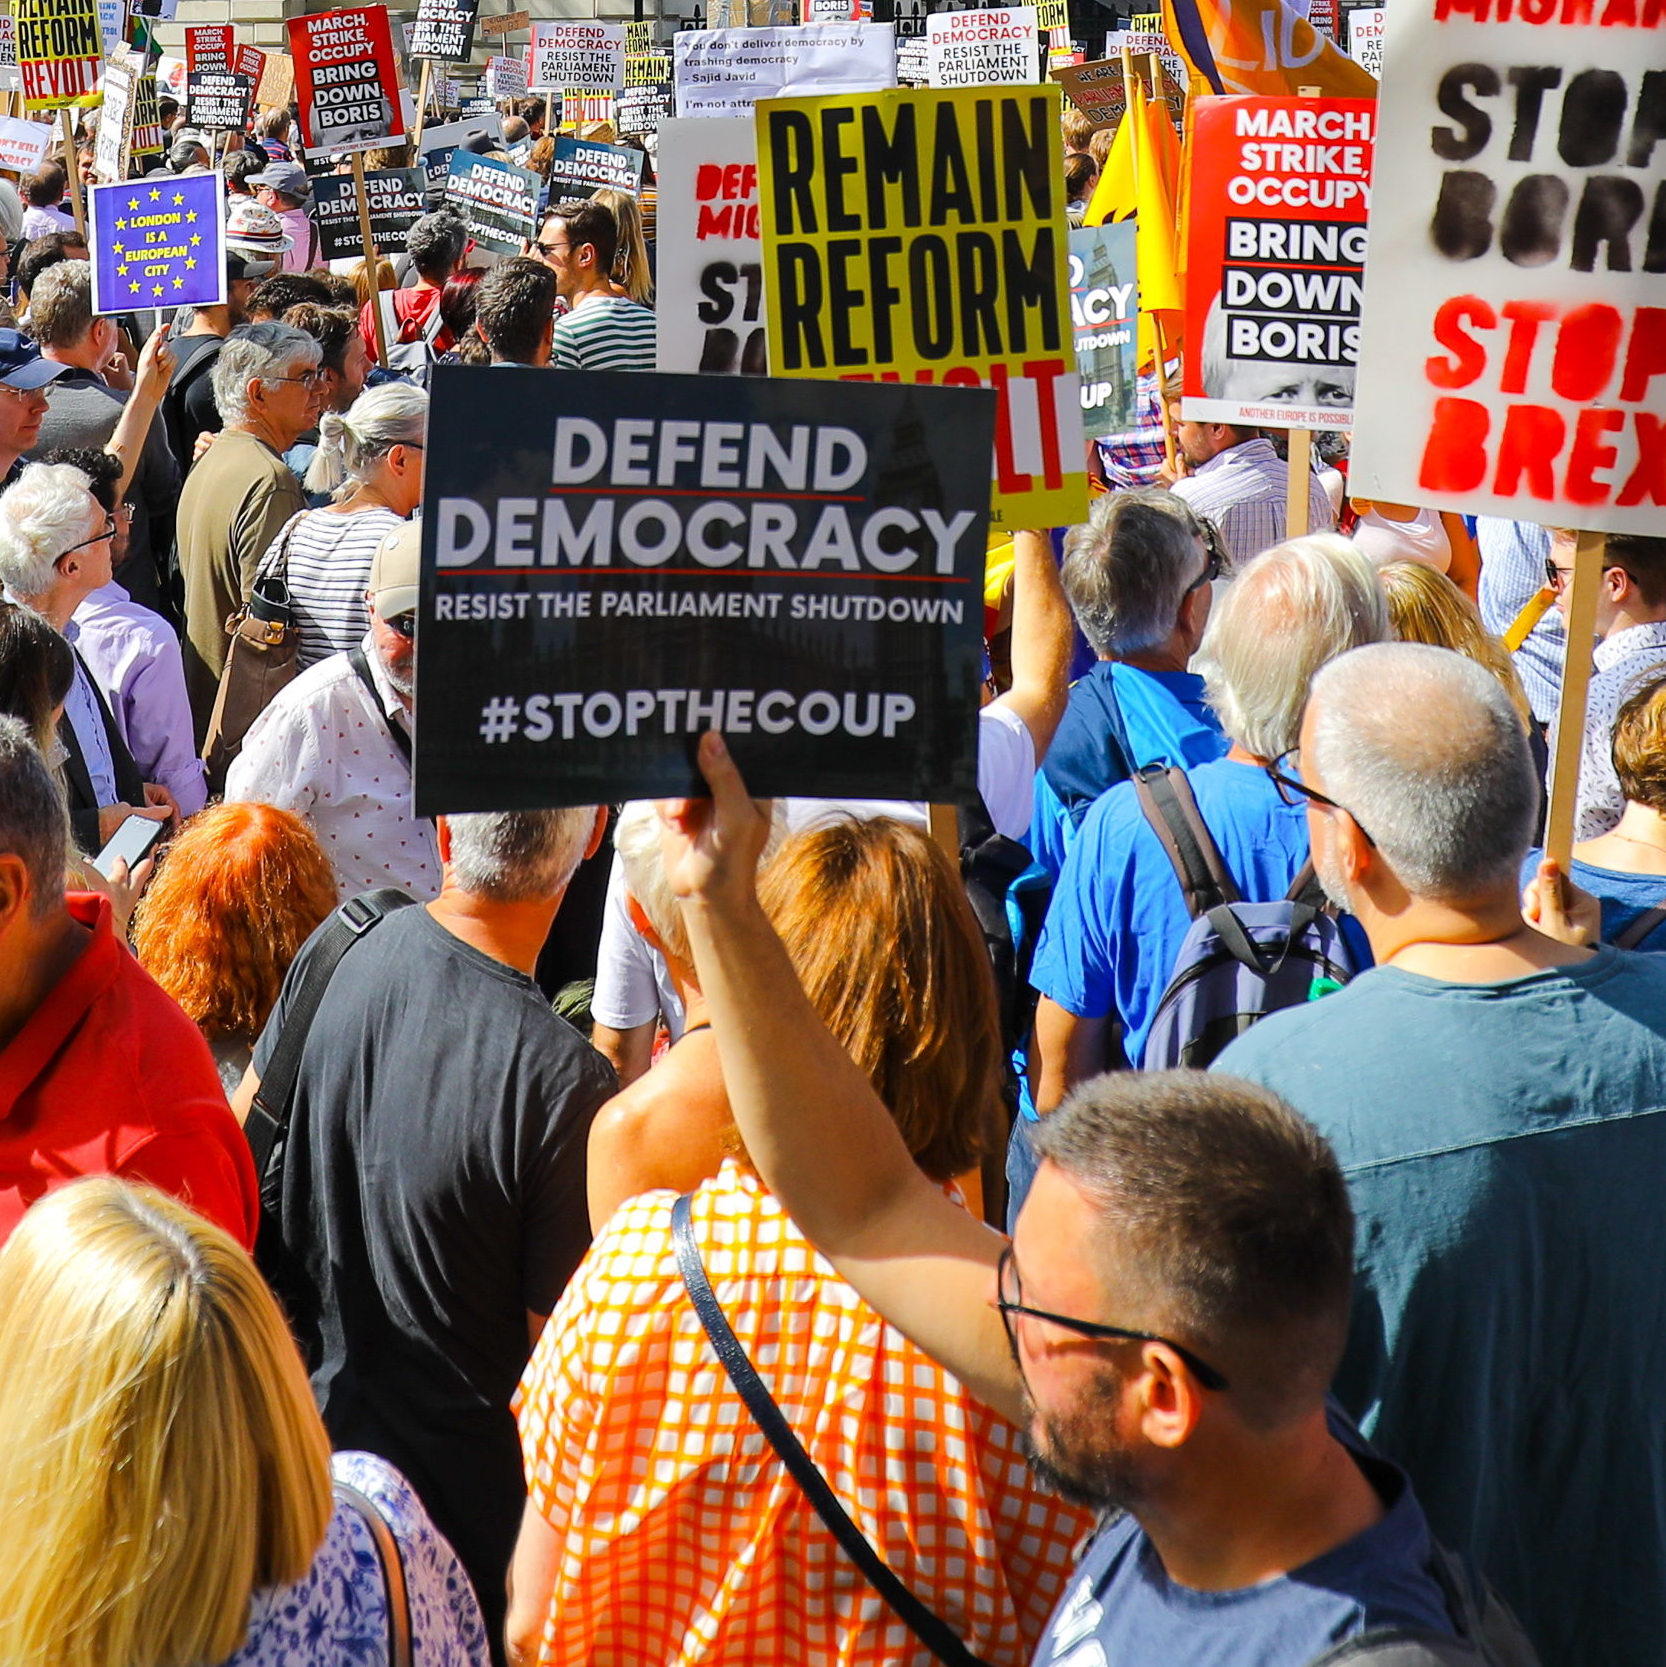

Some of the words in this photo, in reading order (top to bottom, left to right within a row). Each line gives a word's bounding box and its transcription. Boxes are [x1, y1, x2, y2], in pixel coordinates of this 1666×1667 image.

[815, 1, 848, 11] BORIS
[307, 12, 369, 34] MARCH,
[951, 13, 1010, 28] DEFEND
[19, 16, 97, 60] REFORM
[312, 28, 368, 47] STRIKE,
[556, 27, 605, 38] DEFEND
[932, 25, 1033, 45] DEMOCRACY
[309, 42, 374, 63] OCCUPY
[538, 38, 622, 51] DEMOCRACY
[684, 42, 706, 51] You
[710, 40, 739, 50] don't
[742, 39, 782, 49] deliver
[784, 38, 848, 49] democracy
[851, 37, 865, 47] by
[944, 43, 989, 59] RESIST
[993, 42, 1021, 55] THE
[547, 51, 586, 63] RESIST
[589, 52, 611, 63] THE
[684, 56, 732, 67] trashing
[736, 54, 799, 66] democracy
[938, 55, 1029, 73] PARLIAMENT
[21, 56, 102, 100] REVOLT
[312, 61, 377, 86] BRING
[541, 62, 617, 74] PARLIAMENT
[542, 71, 614, 83] SHUTDOWN
[692, 73, 721, 84] Sajid
[725, 72, 756, 82] Javid
[940, 70, 1027, 86] SHUTDOWN
[201, 75, 235, 86] DEFEND
[189, 85, 247, 97] DEMOCRACY
[314, 82, 381, 107] DOWN
[709, 100, 726, 109] not
[320, 104, 381, 128] BORIS
[1236, 108, 1376, 144] MARCH,
[575, 147, 627, 169] DEFEND
[770, 96, 1053, 235] REMAIN
[1240, 142, 1369, 176] STRIKE,
[471, 162, 525, 192] DEFEND
[553, 160, 641, 188] DEMOCRACY
[447, 173, 539, 213] DEMOCRACY
[1227, 176, 1372, 209] OCCUPY
[131, 212, 181, 228] LONDON
[146, 232, 156, 243] IS
[158, 231, 167, 241] A
[1229, 220, 1368, 263] BRING
[125, 246, 187, 262] EUROPEAN
[145, 264, 169, 277] CITY
[776, 227, 1061, 371] REFORM
[1226, 268, 1364, 311] DOWN
[1239, 406, 1274, 419] ANOTHER
[552, 416, 869, 492] DEFEND
[436, 496, 977, 577] DEMOCRACY
[435, 593, 529, 622] RESIST
[537, 592, 591, 618] THE
[600, 592, 779, 620] PARLIAMENT
[790, 595, 964, 625] SHUTDOWN
[479, 689, 916, 744] #STOPTHECOUP
